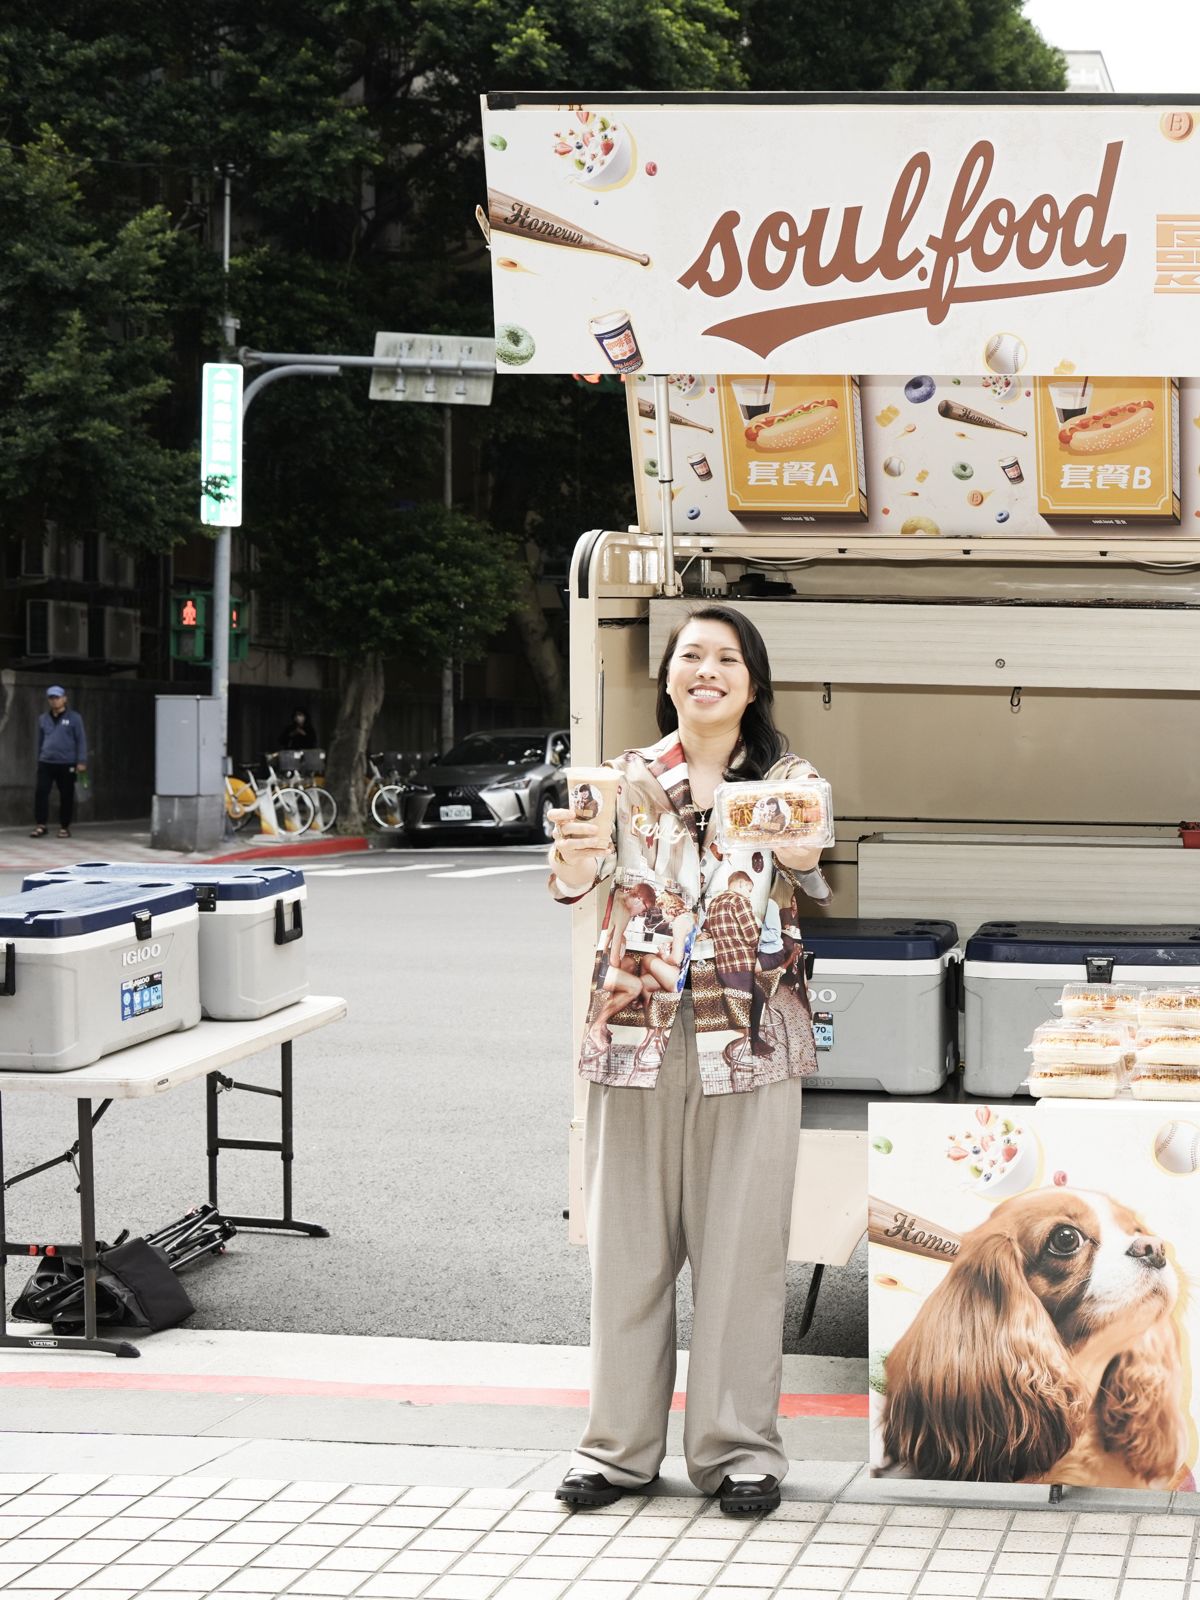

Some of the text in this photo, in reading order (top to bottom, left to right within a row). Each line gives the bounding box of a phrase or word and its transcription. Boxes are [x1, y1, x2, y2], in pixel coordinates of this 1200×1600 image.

[504, 202, 583, 244] Homerun
[747, 460, 839, 487] 套餐A
[1060, 463, 1152, 490] 套餐B
[122, 943, 161, 967] IGLOO
[815, 1026, 826, 1034] 70
